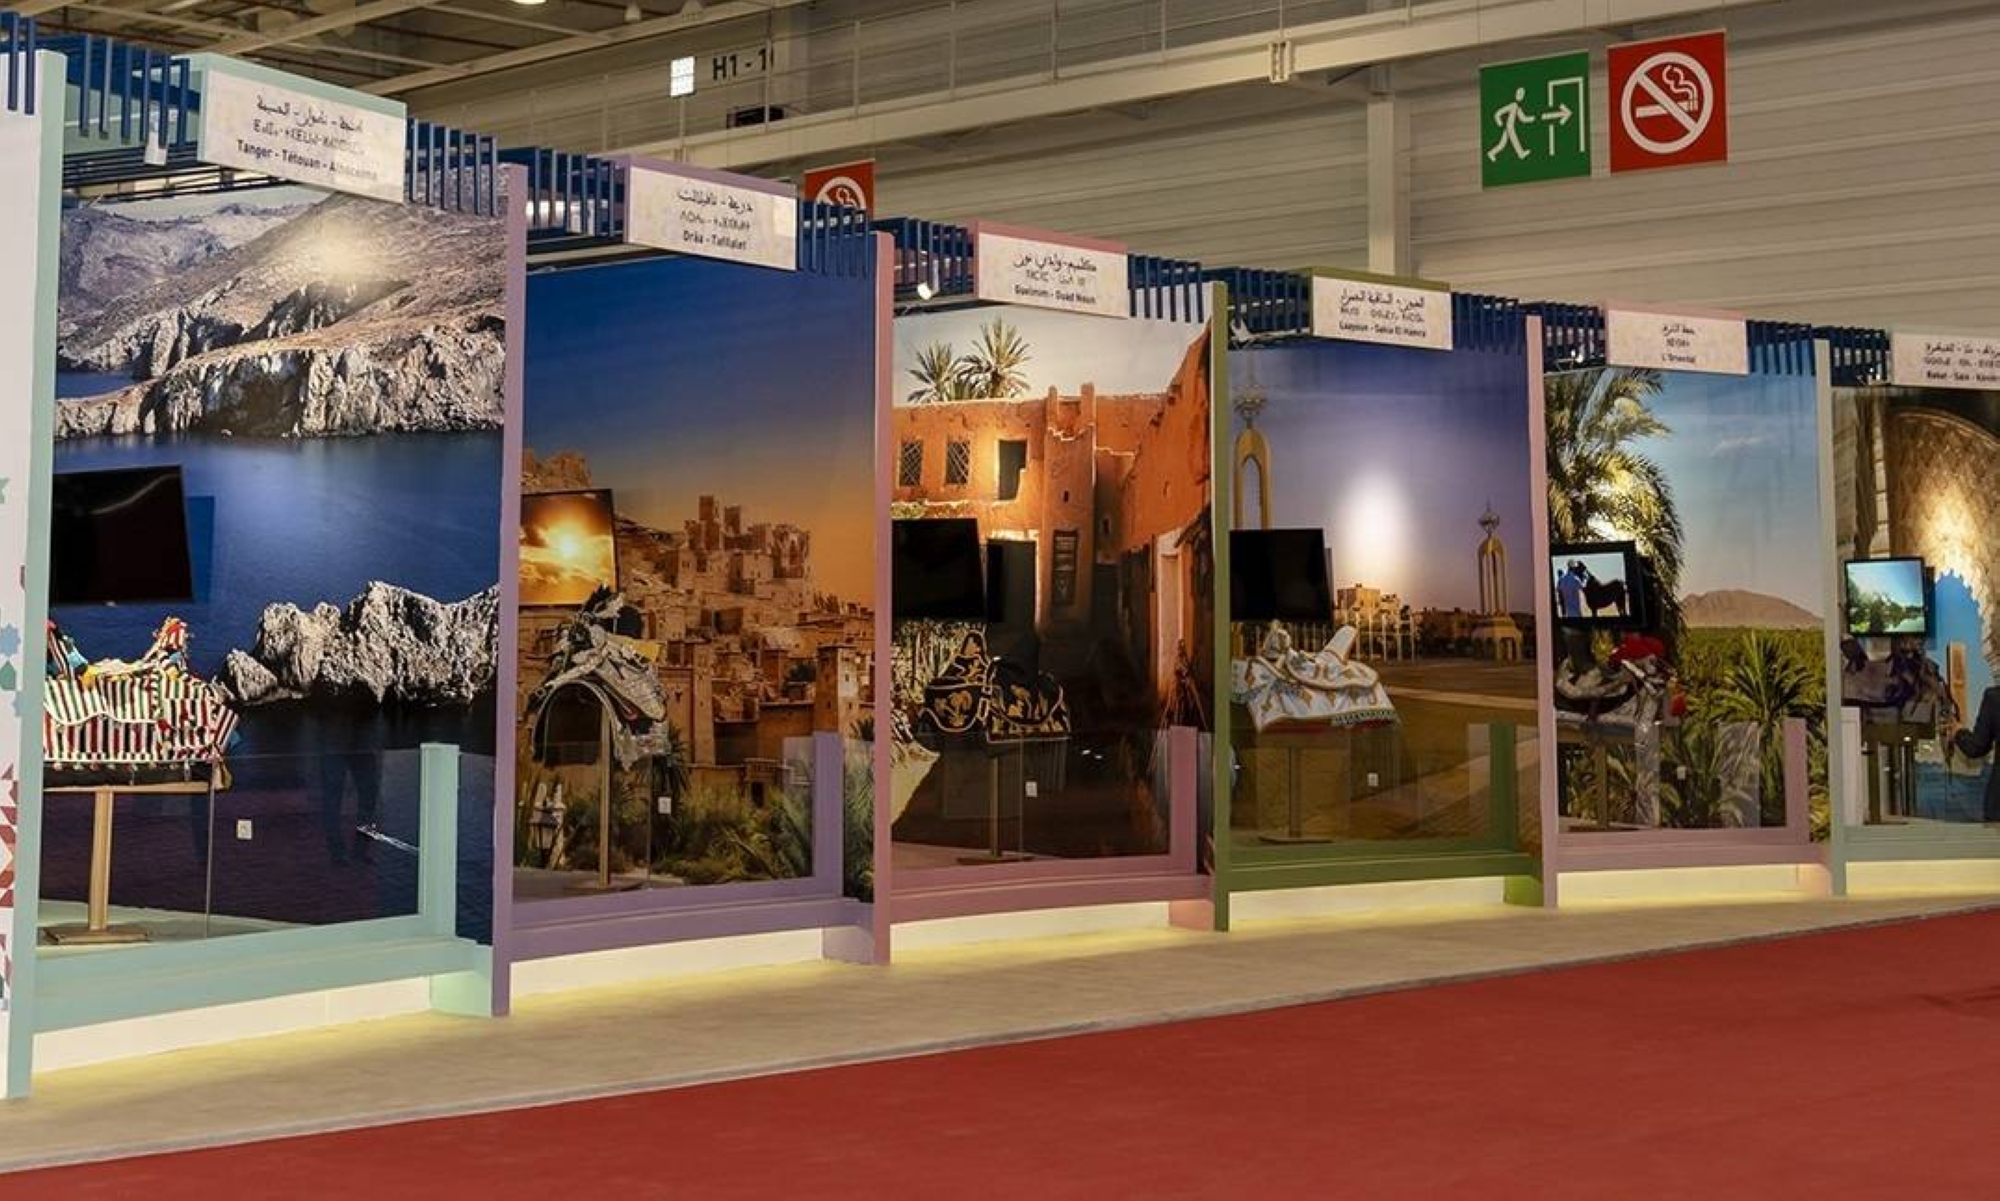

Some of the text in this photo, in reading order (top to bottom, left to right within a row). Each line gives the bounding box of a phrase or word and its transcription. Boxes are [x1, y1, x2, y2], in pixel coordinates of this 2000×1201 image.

[713, 54, 737, 80] H1
[758, 48, 774, 71] 1
[237, 139, 273, 160] Tanger
